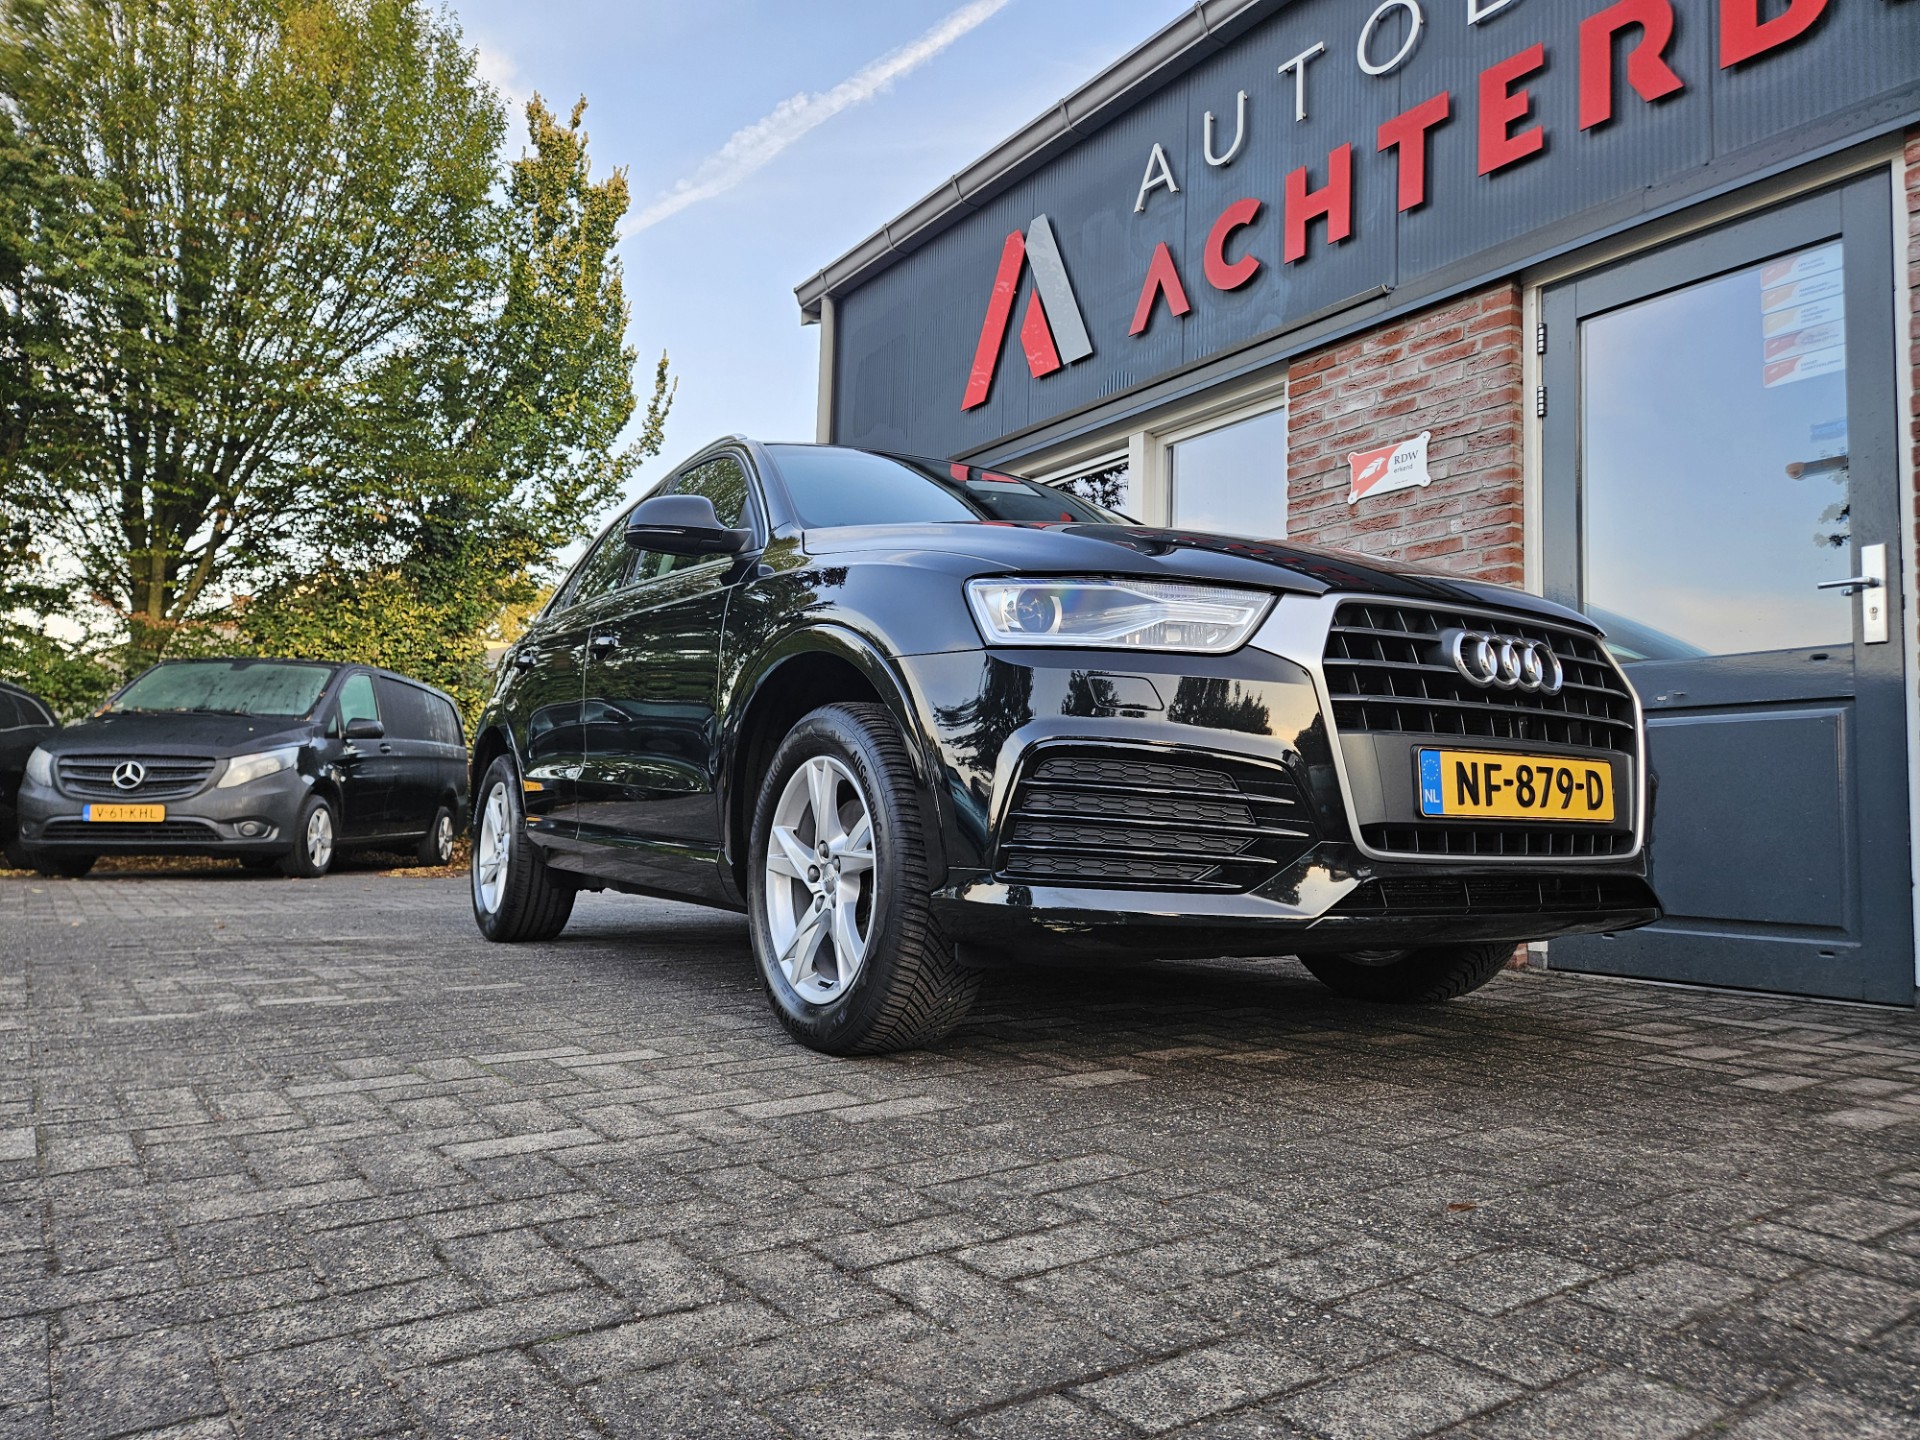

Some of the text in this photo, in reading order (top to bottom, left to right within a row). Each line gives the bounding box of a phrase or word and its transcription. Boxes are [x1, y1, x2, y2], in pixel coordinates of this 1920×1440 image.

[1394, 449, 1418, 464] RDW
[1394, 463, 1413, 473] erkend
[1455, 761, 1603, 811] NF-879-D
[1424, 788, 1440, 804] NL
[97, 807, 157, 819] V-61-KHL
